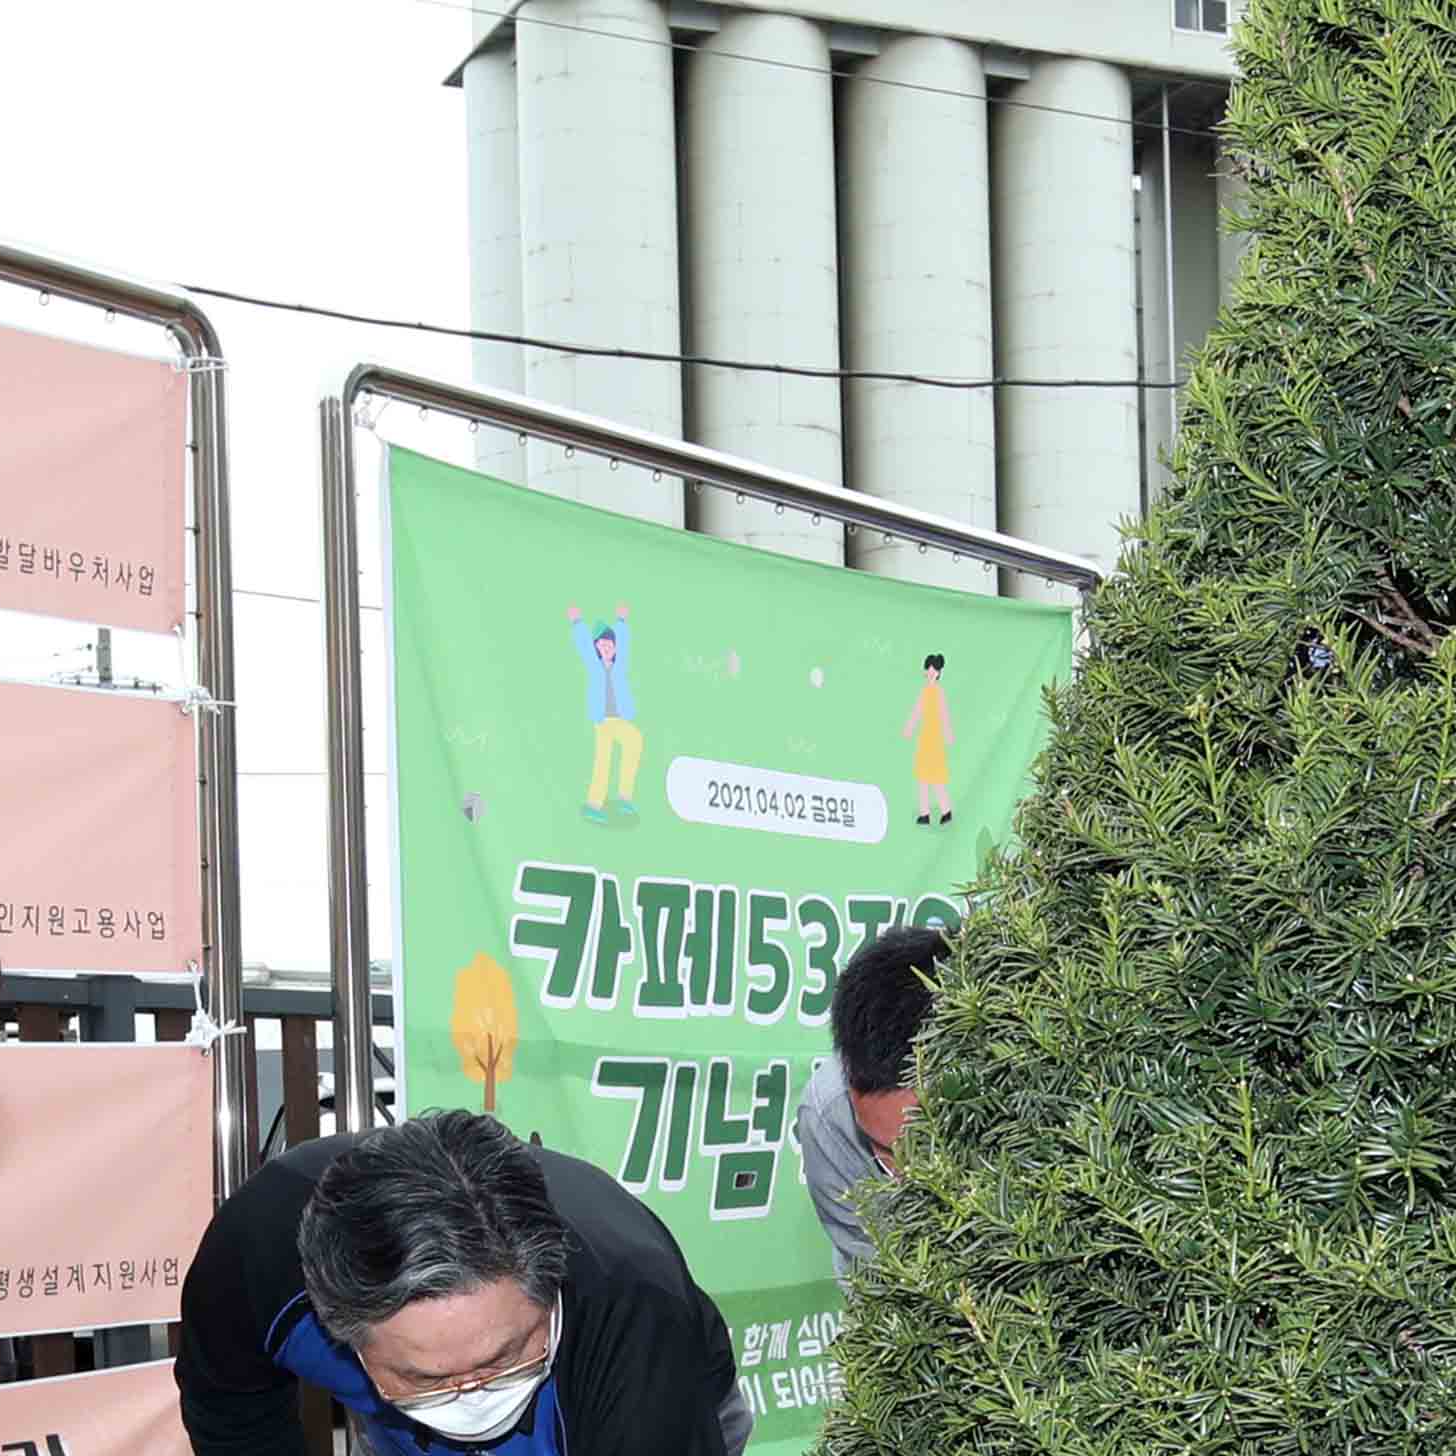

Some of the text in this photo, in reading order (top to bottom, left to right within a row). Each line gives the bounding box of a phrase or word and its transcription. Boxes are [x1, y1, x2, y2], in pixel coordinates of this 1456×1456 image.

[707, 779, 856, 829] 2021.04.02 금요일
[740, 1319, 792, 1368] 함께
